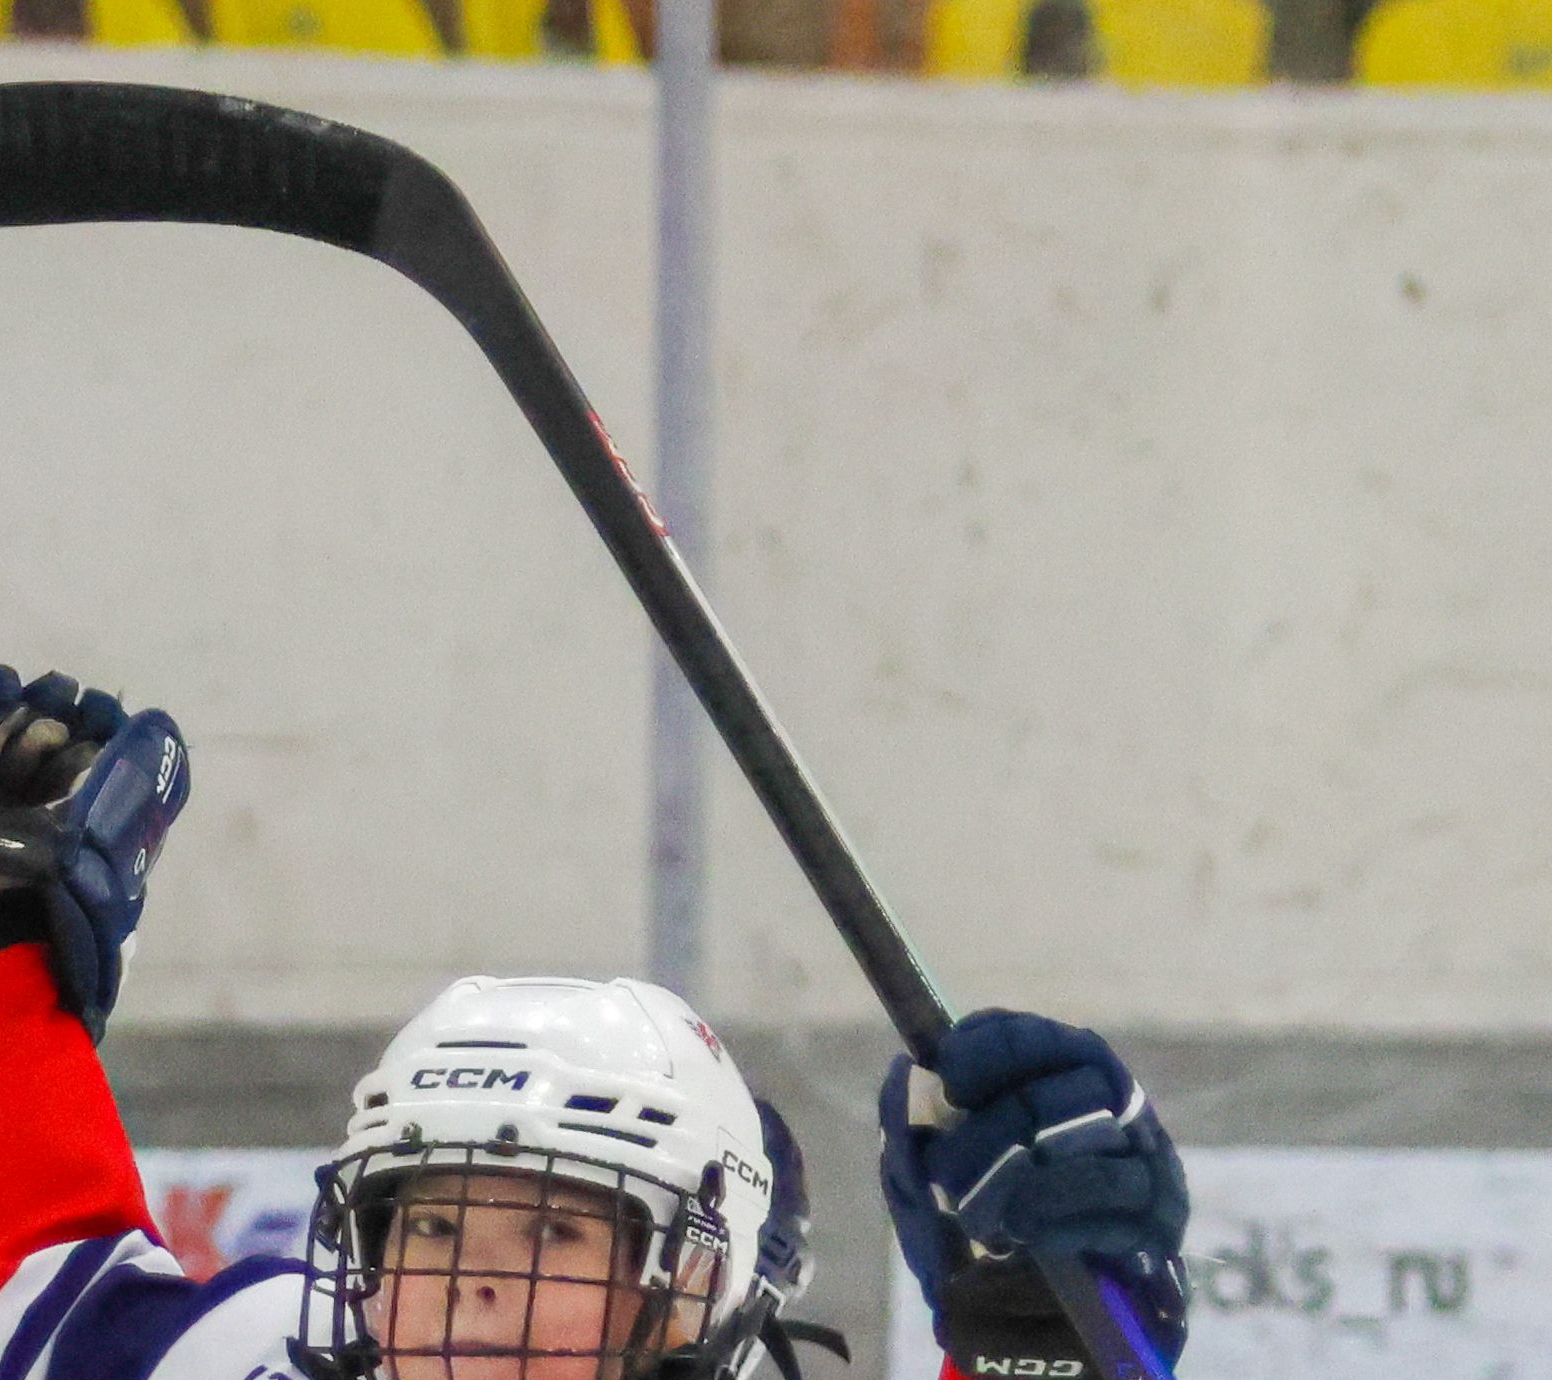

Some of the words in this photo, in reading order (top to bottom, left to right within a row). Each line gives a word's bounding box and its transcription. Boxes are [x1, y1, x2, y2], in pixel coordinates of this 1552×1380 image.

[410, 1068, 532, 1091] CCM
[722, 1149, 769, 1196] CCM
[686, 1225, 729, 1255] CCM
[974, 1355, 1084, 1377] CCM
